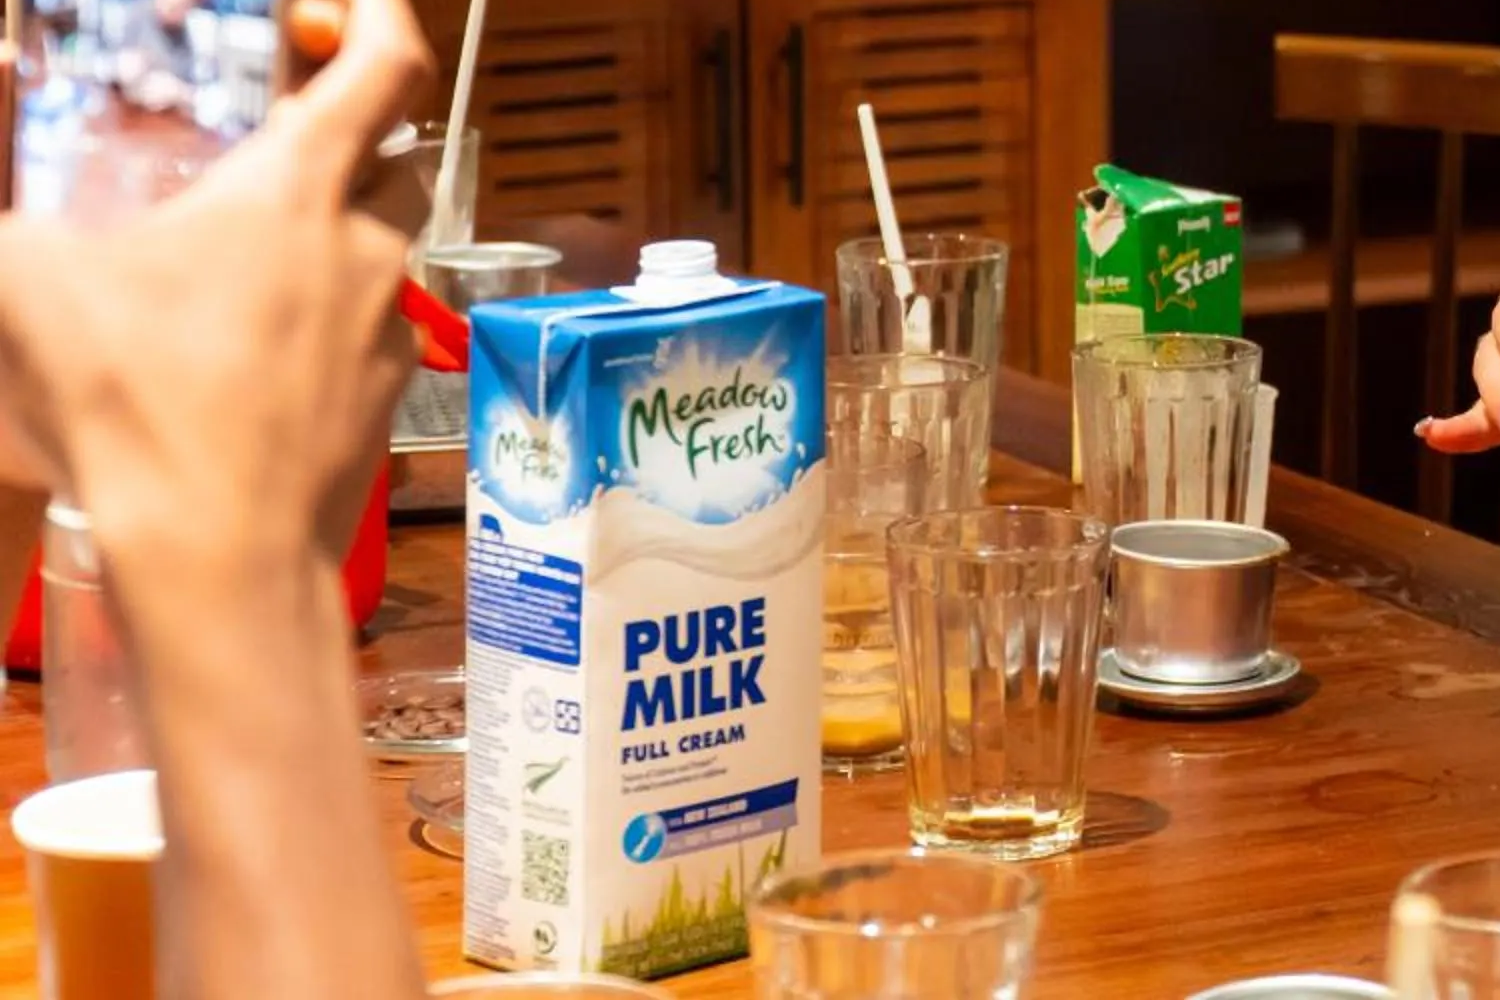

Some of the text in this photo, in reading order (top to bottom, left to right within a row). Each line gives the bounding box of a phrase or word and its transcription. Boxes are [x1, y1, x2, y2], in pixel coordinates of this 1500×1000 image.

[1174, 252, 1235, 295] Star
[628, 365, 788, 468] Meadow
[686, 413, 784, 480] Fresh
[624, 596, 766, 673] PURE
[620, 654, 767, 732] MILK
[621, 723, 745, 765] FULL CREAM
